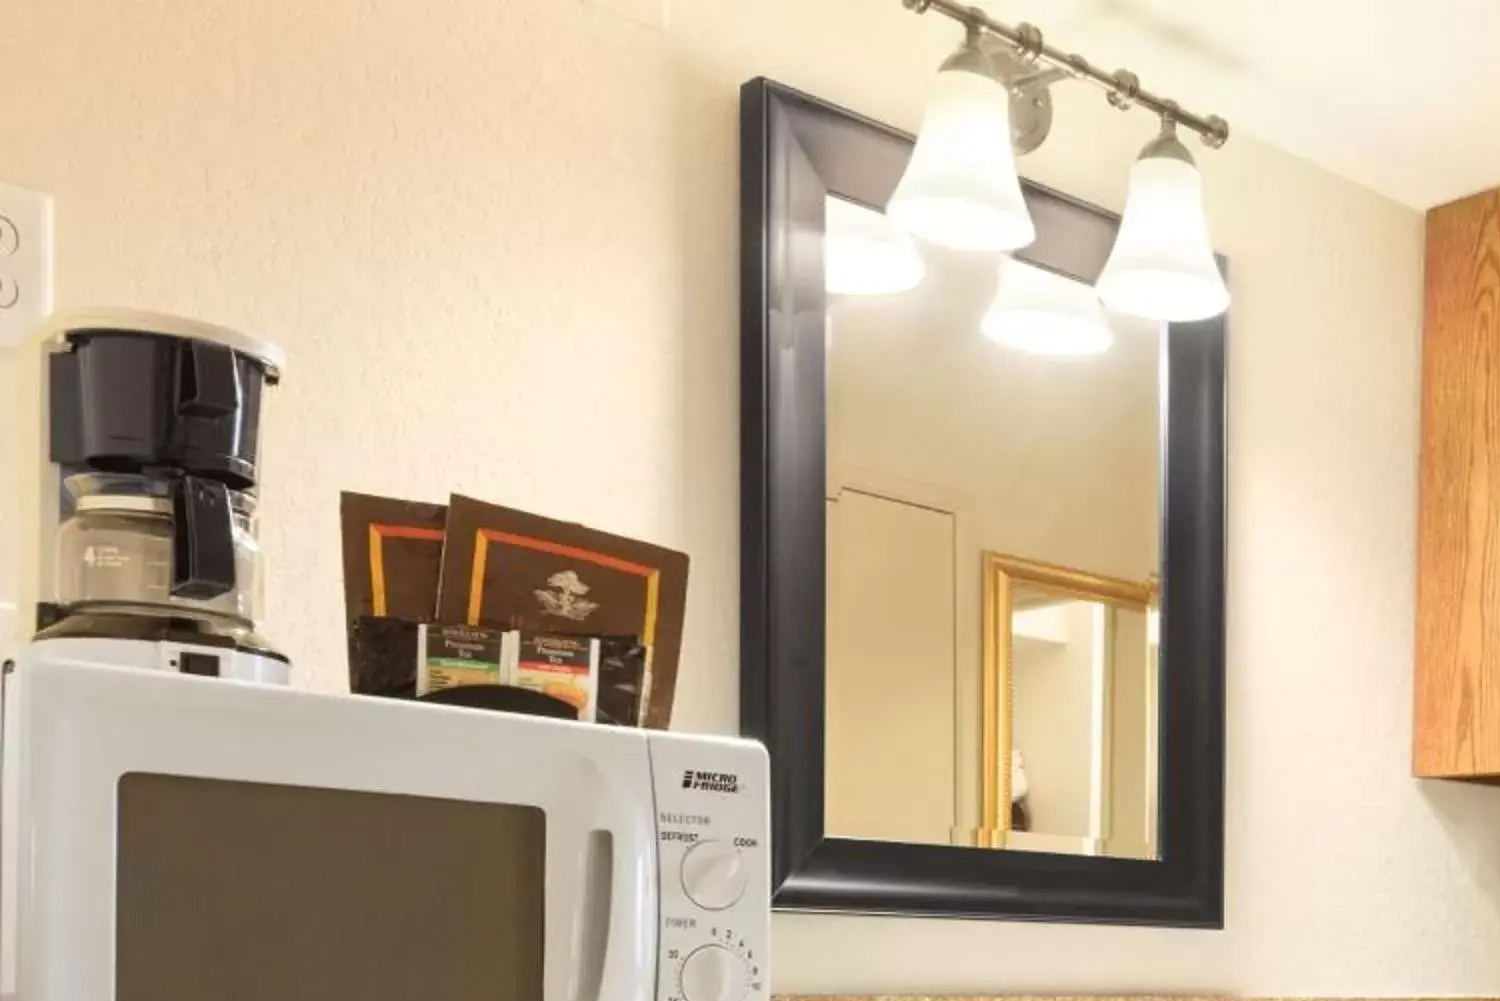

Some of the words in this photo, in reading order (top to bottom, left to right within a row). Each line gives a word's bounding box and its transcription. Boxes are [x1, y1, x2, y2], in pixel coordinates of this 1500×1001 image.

[696, 771, 737, 783] MICRO
[693, 780, 738, 793] FRIDGE
[660, 812, 710, 825] SELECTOR
[733, 837, 758, 848] COOK
